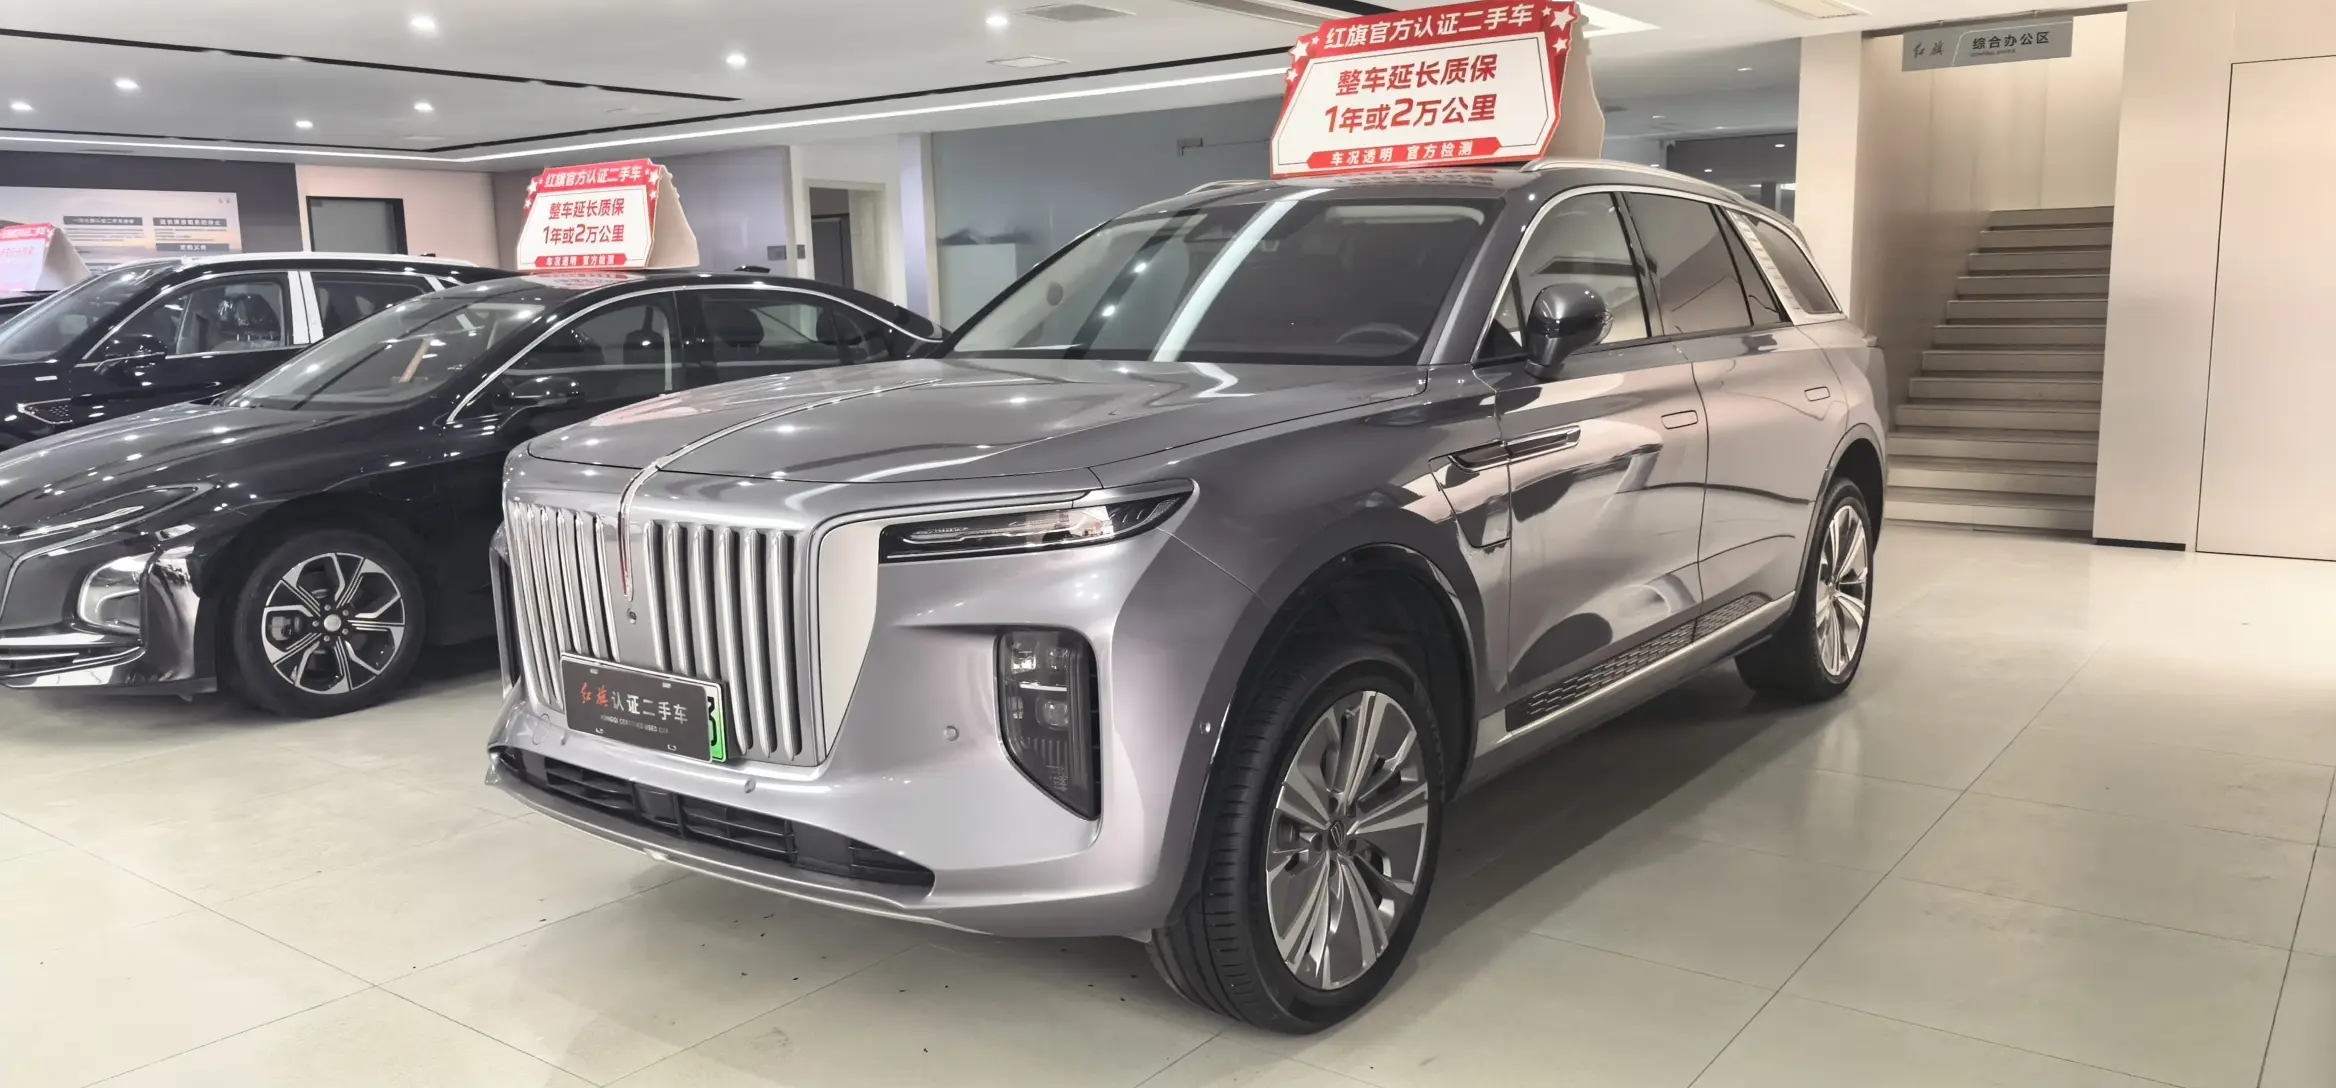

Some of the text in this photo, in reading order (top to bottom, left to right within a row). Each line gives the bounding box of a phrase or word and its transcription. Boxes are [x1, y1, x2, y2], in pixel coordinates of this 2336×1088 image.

[1324, 3, 1534, 49] 红旗官方认证二手车
[1972, 31, 2050, 50] 综合办公区
[1336, 53, 1498, 97] 整车延长质保
[1324, 93, 1498, 134] 1年或2万公里
[1330, 140, 1473, 167] 车况透明 官方检测
[544, 165, 643, 188] 红旗官方认证二手车
[548, 198, 625, 220] 整车延长质保
[543, 223, 625, 245] 1年或2万公里
[580, 682, 688, 725] 红旗认证二手车
